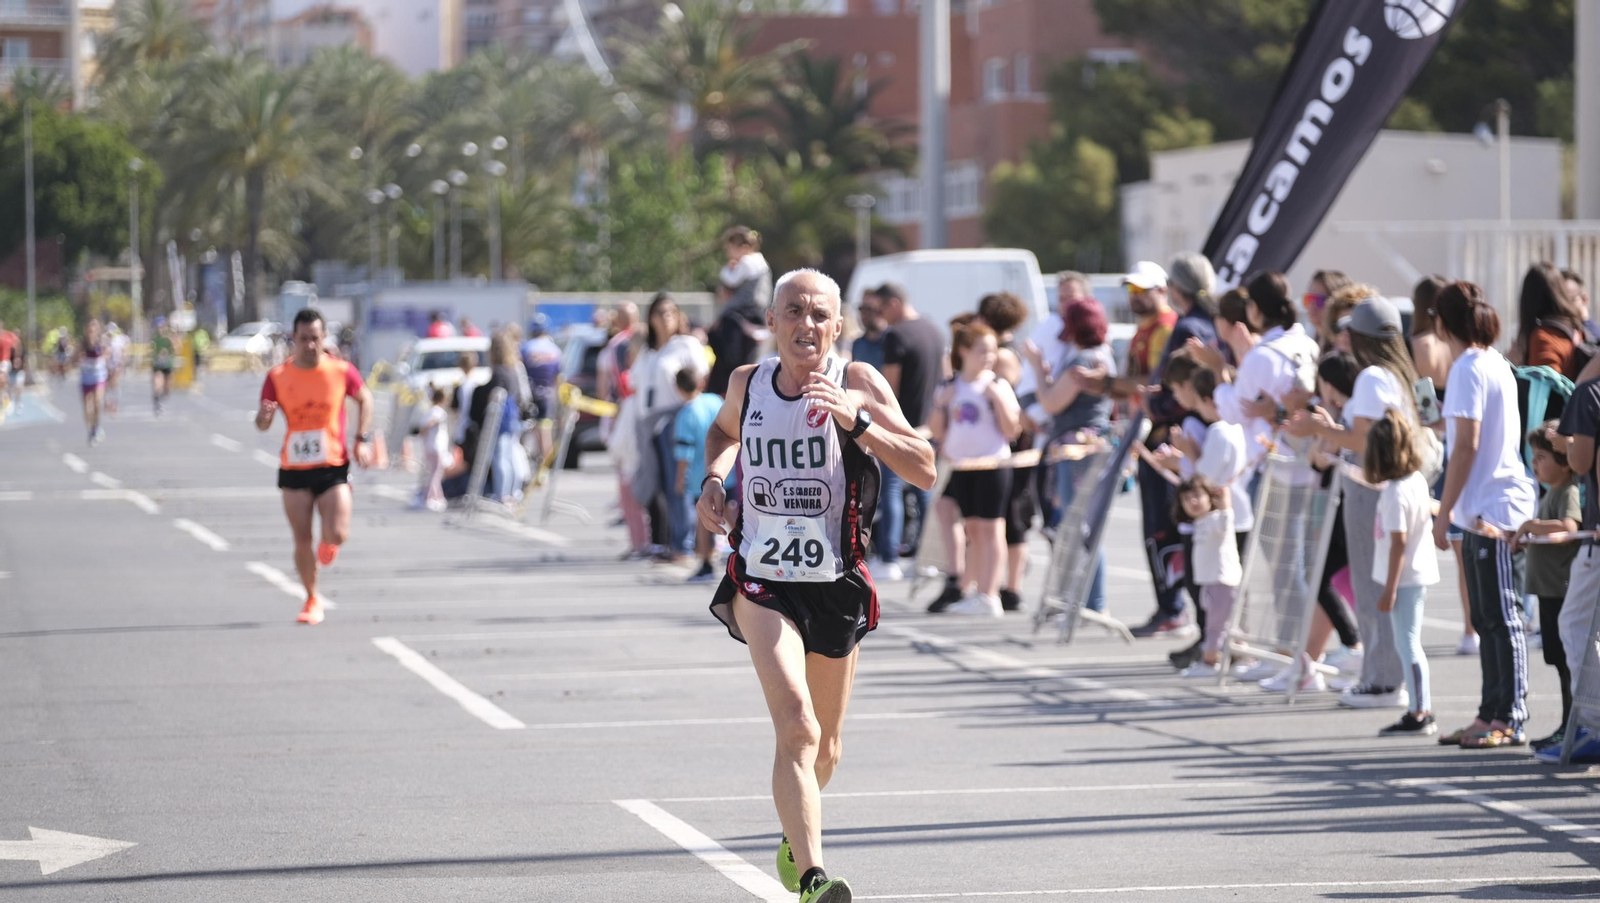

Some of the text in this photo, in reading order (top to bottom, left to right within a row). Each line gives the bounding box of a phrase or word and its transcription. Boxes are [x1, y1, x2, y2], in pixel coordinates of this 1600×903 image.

[746, 435, 826, 469] UNED
[796, 486, 822, 496] CABEZO
[783, 498, 822, 509] VENTURA
[759, 537, 824, 568] 249
